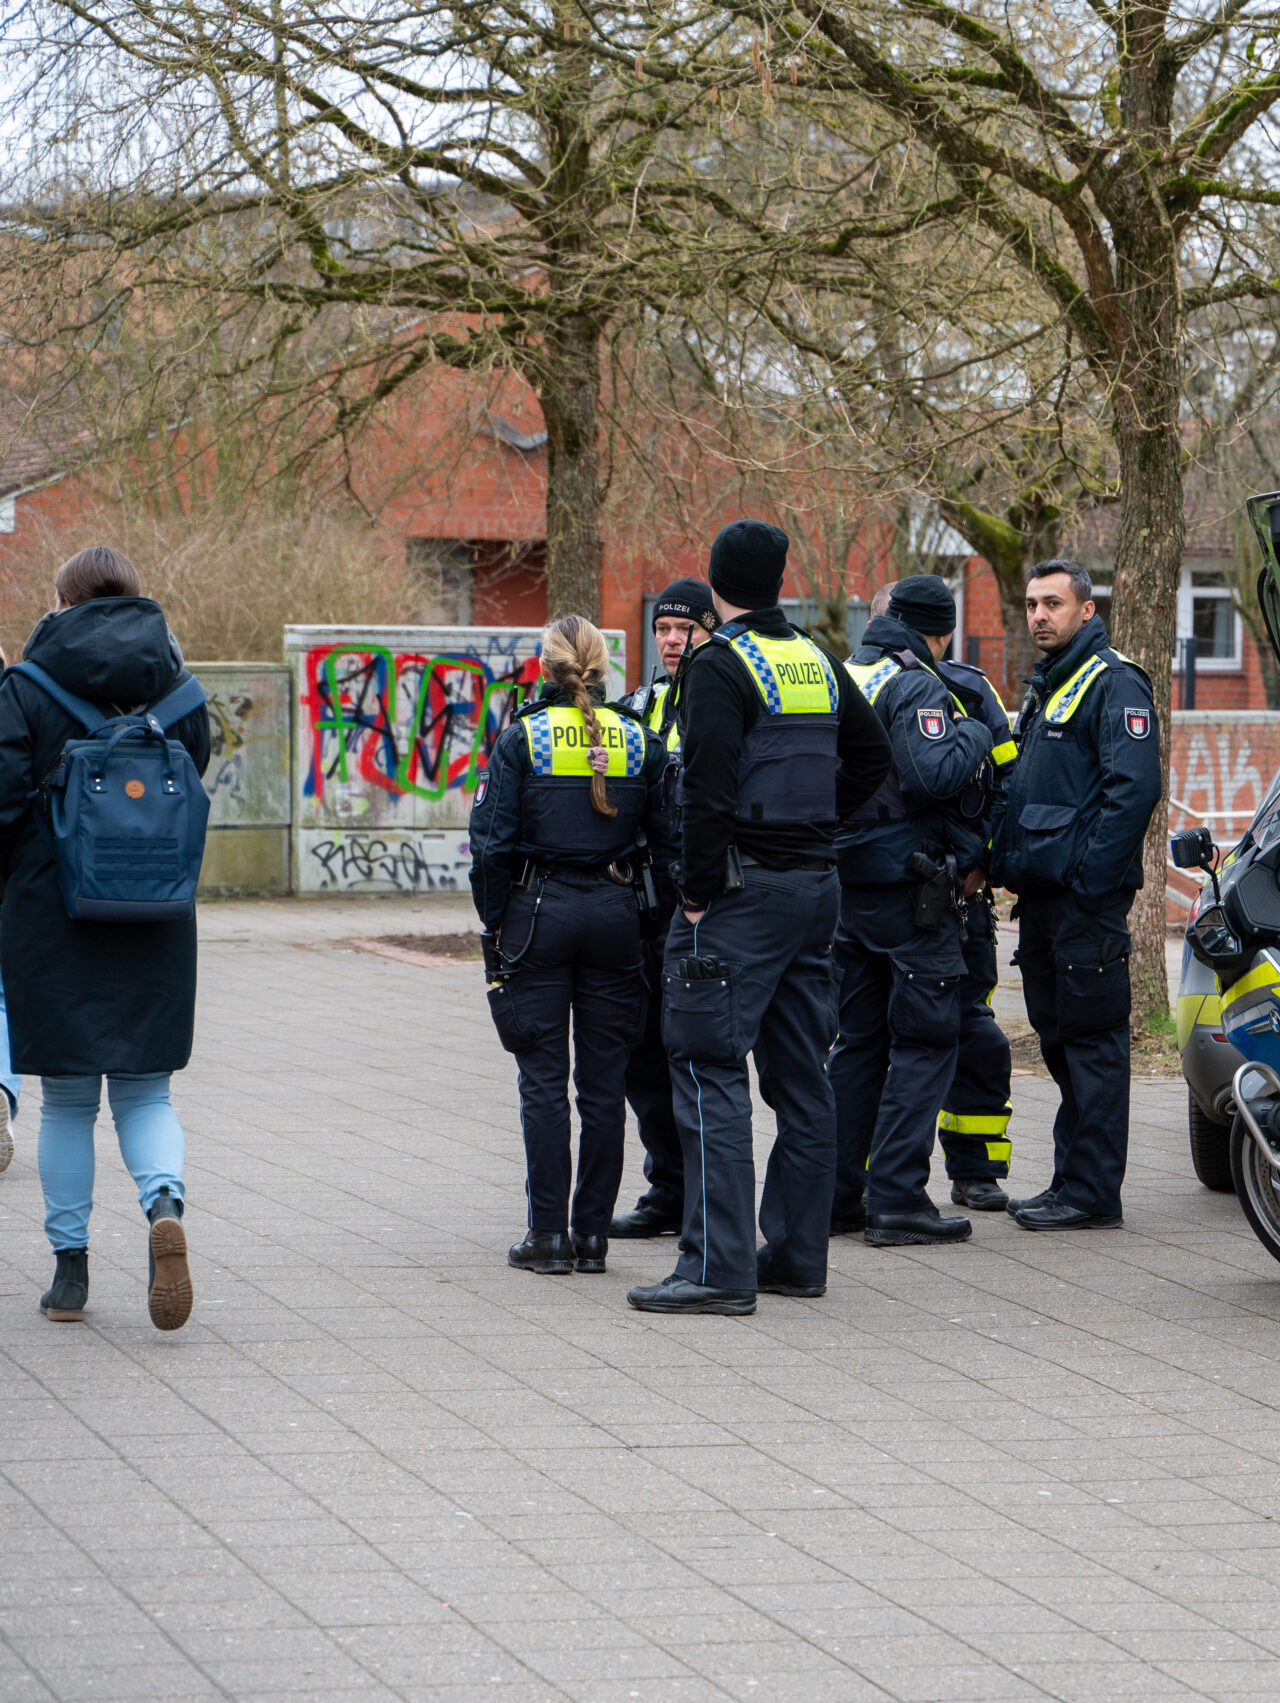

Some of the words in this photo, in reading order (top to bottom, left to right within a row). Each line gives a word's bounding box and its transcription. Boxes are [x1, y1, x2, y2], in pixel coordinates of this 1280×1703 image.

[659, 603, 690, 613] POLIZEI
[775, 662, 824, 685] POLIZEI
[1126, 709, 1149, 718] POLIZEI
[553, 725, 625, 749] POLZEI
